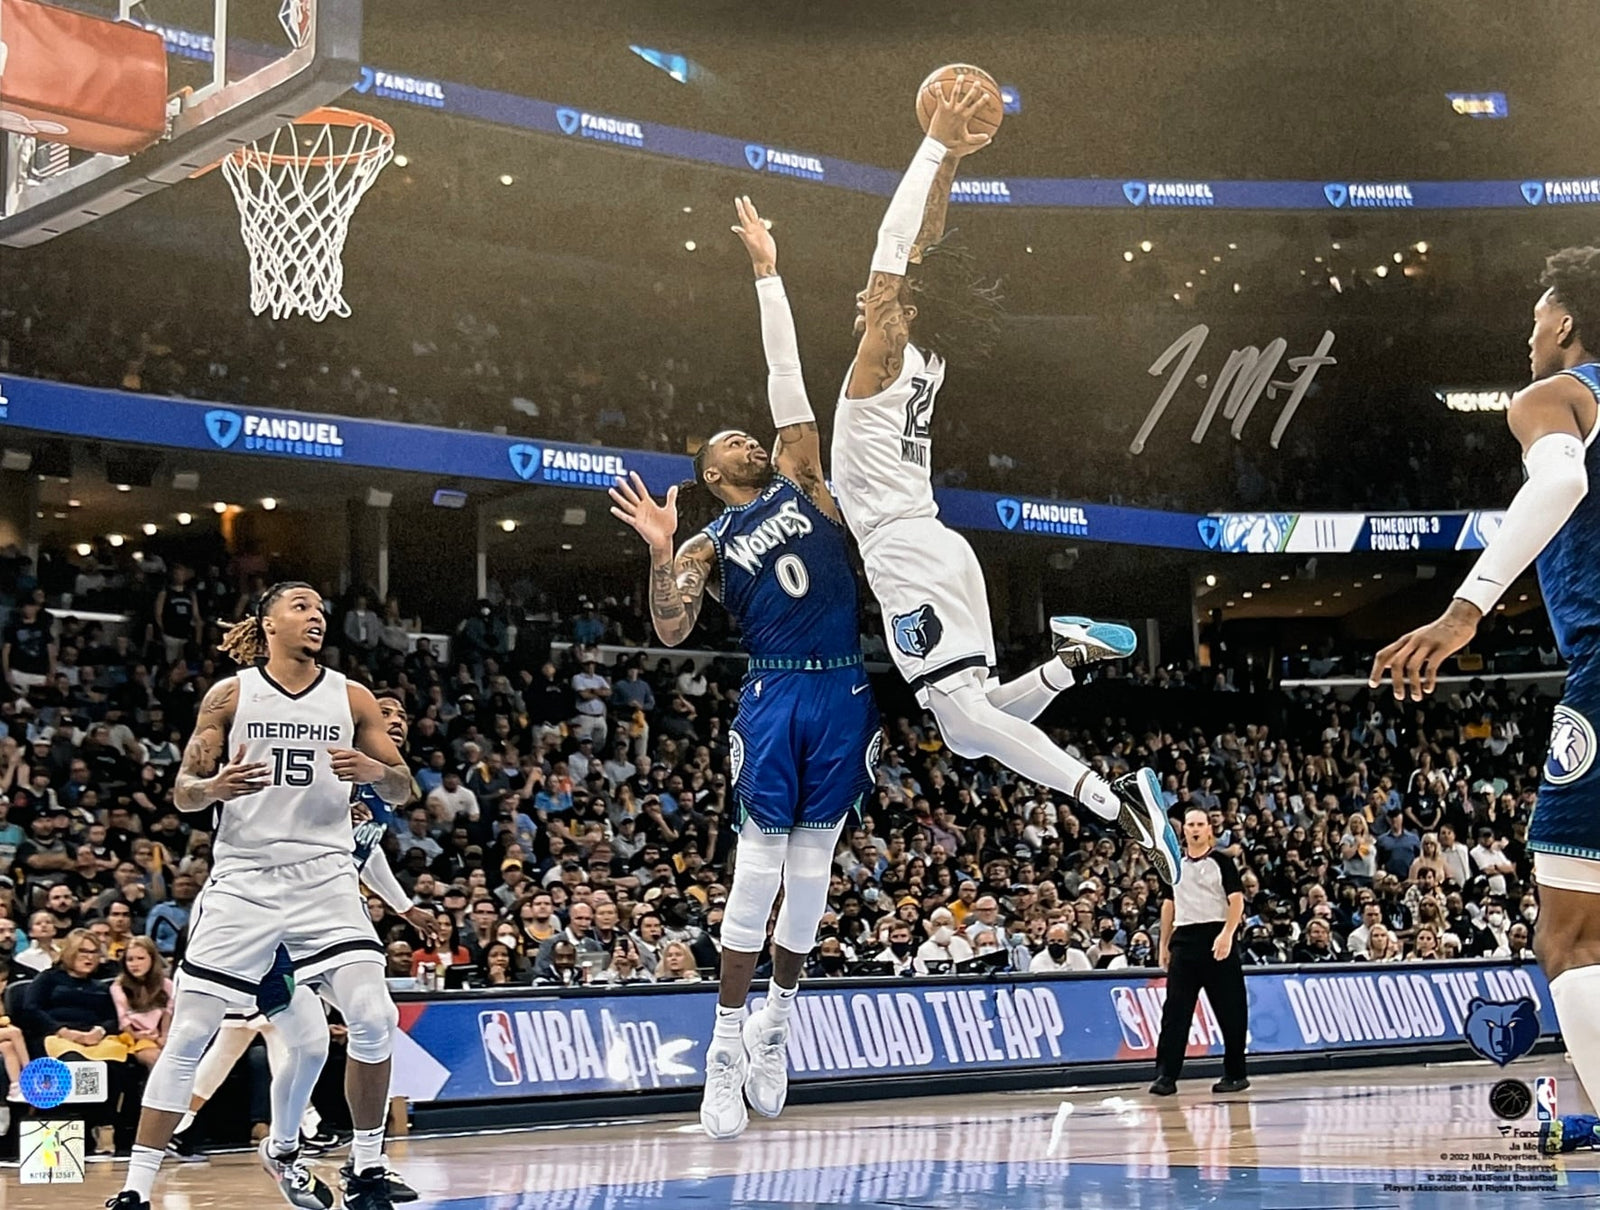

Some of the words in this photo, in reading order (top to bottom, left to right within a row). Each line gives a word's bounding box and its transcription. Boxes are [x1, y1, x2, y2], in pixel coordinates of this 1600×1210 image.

[375, 72, 444, 98] FANDUEL
[580, 114, 643, 138] FANDUEL
[767, 150, 823, 172] FANDUEL
[950, 181, 1010, 195] ANDUEL
[1148, 184, 1213, 198] FANDUEL
[1349, 184, 1413, 199] FANDUEL
[1545, 181, 1600, 197] FANDUE
[244, 415, 343, 445] FANDUEL
[542, 449, 628, 476] FANDUEL
[1022, 502, 1088, 526] FANDUEL
[1370, 517, 1430, 534] TIMEOUTS:
[1431, 516, 1440, 533] 3
[724, 497, 814, 576] WOLVES
[1371, 534, 1410, 550] FOULS:
[1411, 534, 1420, 550] 4
[774, 553, 810, 598] 0
[247, 722, 341, 741] MEMPHIS
[271, 747, 316, 787] 15
[1283, 973, 1447, 1045] DOWNLOAD
[924, 989, 1004, 1064] THE
[996, 986, 1065, 1060] APP
[514, 1008, 606, 1083] NBA
